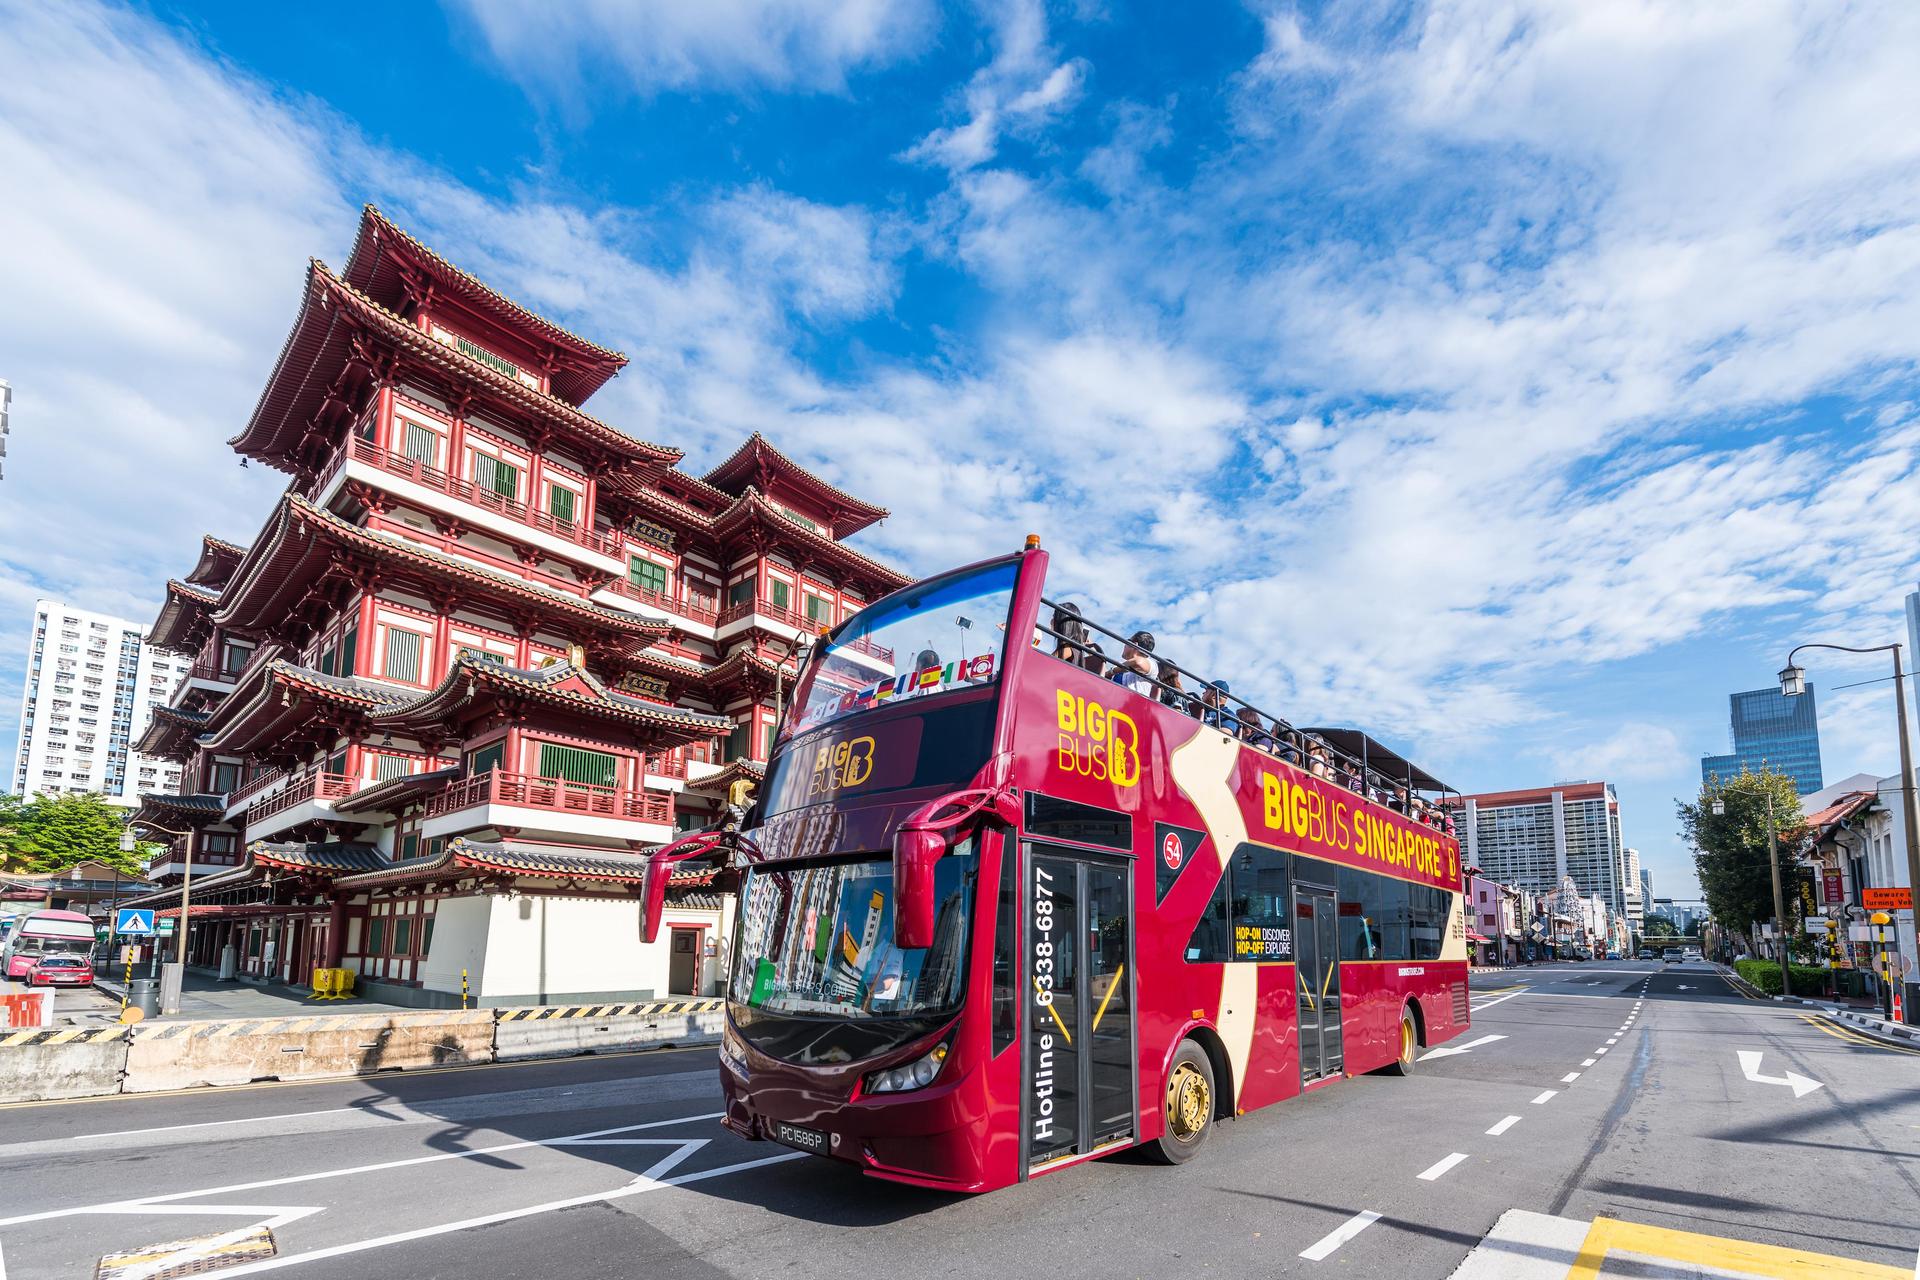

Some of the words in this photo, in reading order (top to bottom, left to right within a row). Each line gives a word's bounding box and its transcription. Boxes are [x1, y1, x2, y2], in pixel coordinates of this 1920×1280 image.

[1056, 688, 1106, 742] BIG
[814, 741, 849, 773] BIG
[1058, 733, 1107, 781] BUS
[809, 767, 844, 796] BUS
[1166, 841, 1181, 861] 54
[1353, 809, 1442, 878] SINGAPORE
[1035, 867, 1054, 1007] 6338-6877
[1235, 926, 1261, 940] HOP-ON
[1262, 928, 1291, 941] DISCOVER
[1236, 941, 1265, 954] HOP-OFF
[1265, 941, 1291, 954] EXPLORE
[1035, 1034, 1054, 1140] Hotline
[780, 1126, 823, 1149] PC1586P
